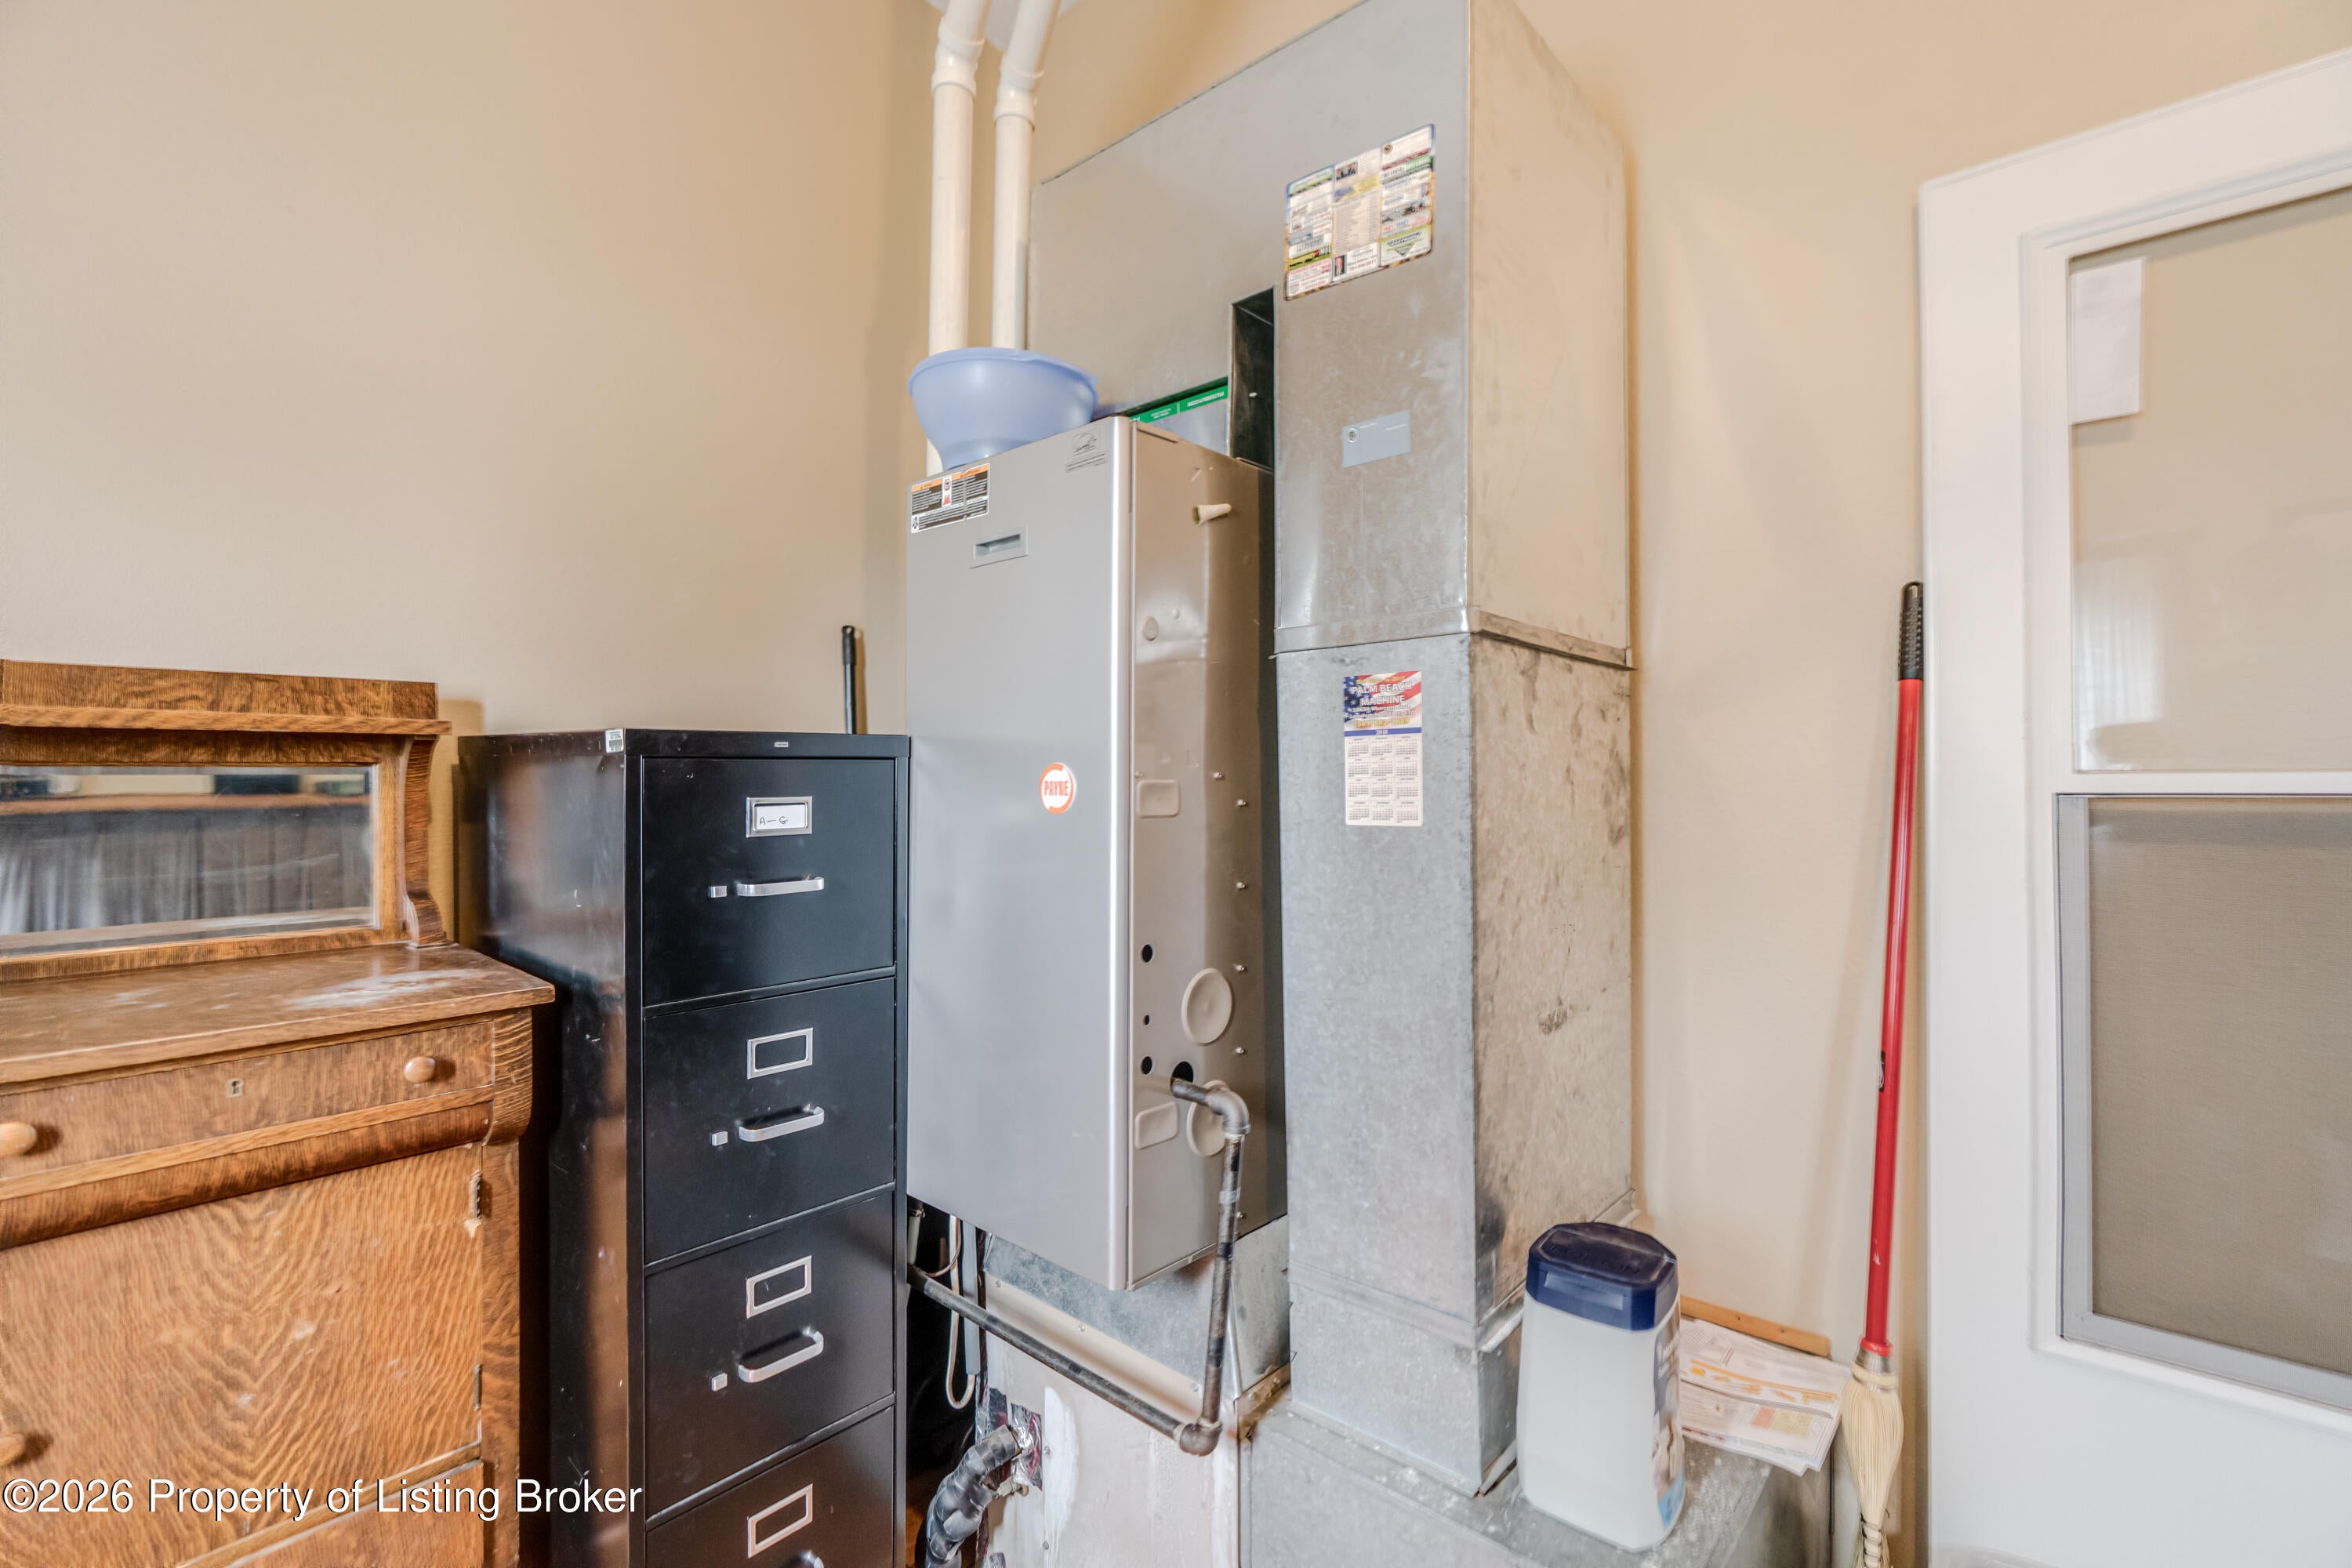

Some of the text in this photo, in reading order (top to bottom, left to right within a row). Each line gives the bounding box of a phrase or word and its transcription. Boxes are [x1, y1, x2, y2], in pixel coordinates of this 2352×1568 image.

[1380, 681, 1412, 692] BEACH
[1360, 695, 1405, 705] MACHINE
[1044, 780, 1069, 796] PAYNE
